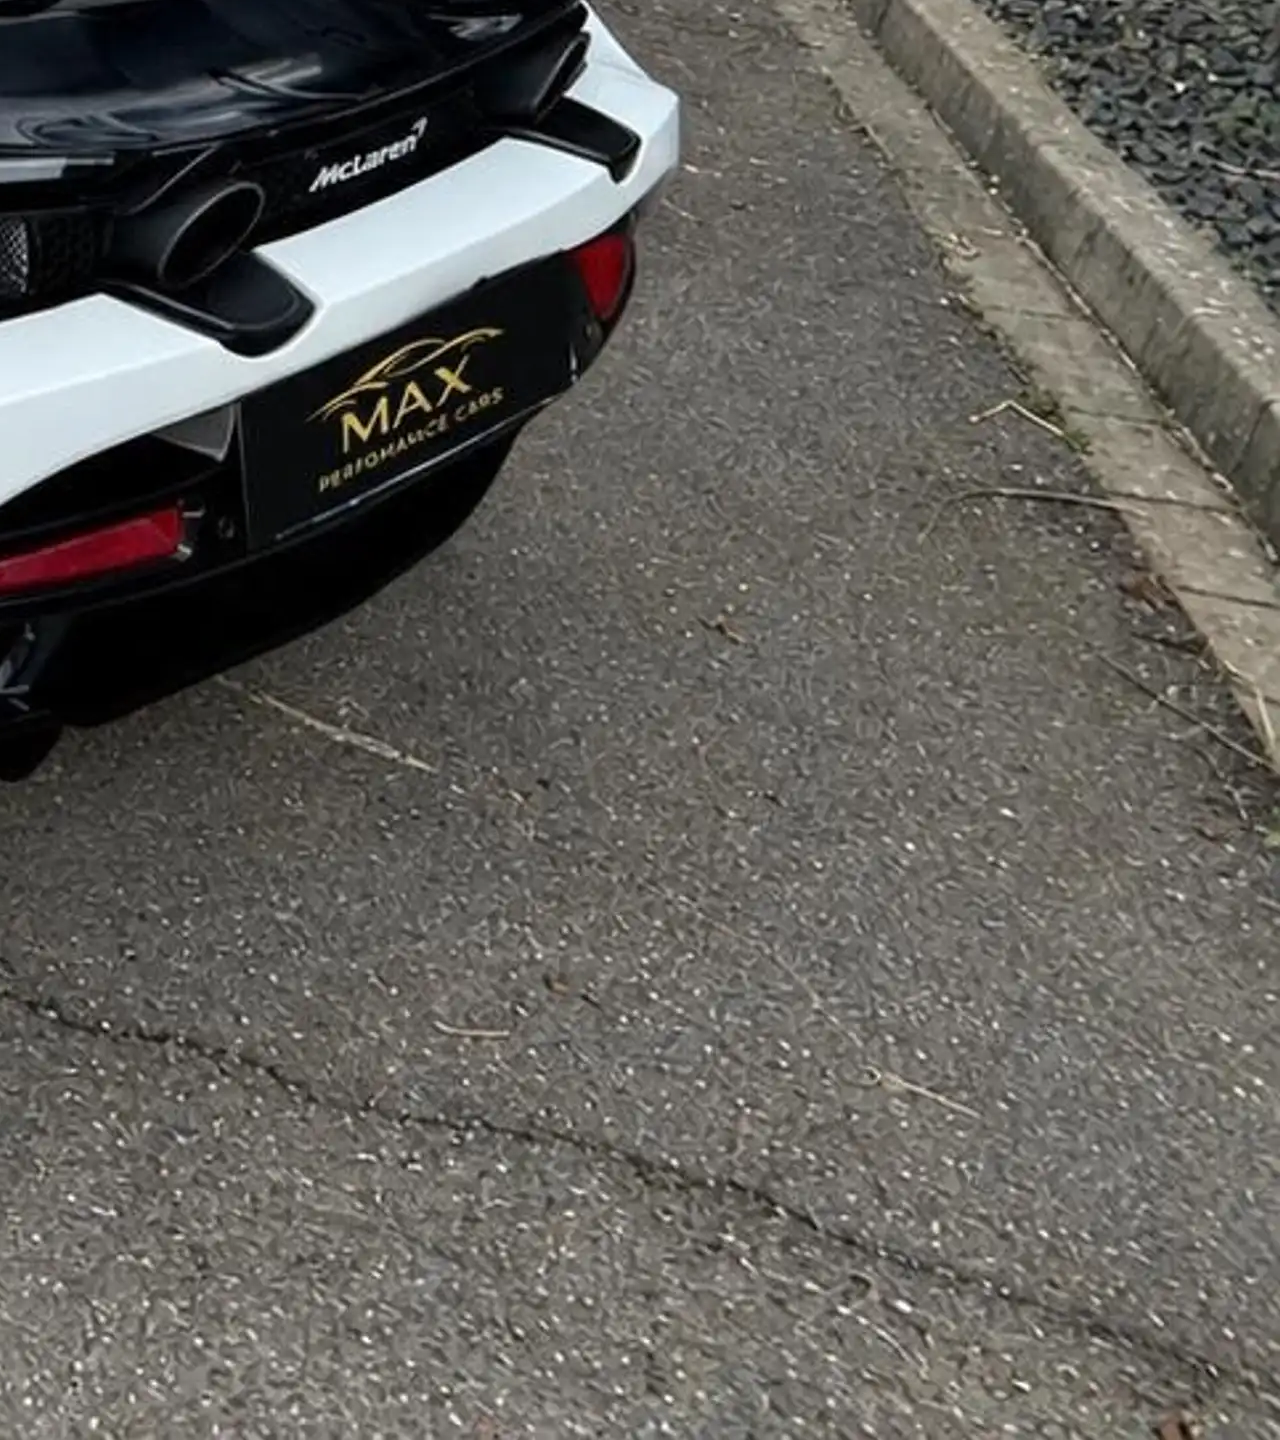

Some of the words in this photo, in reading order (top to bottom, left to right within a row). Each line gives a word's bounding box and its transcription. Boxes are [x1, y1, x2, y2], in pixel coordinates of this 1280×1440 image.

[308, 133, 419, 192] McLaren
[342, 353, 472, 454] MAX
[454, 386, 505, 422] CARS
